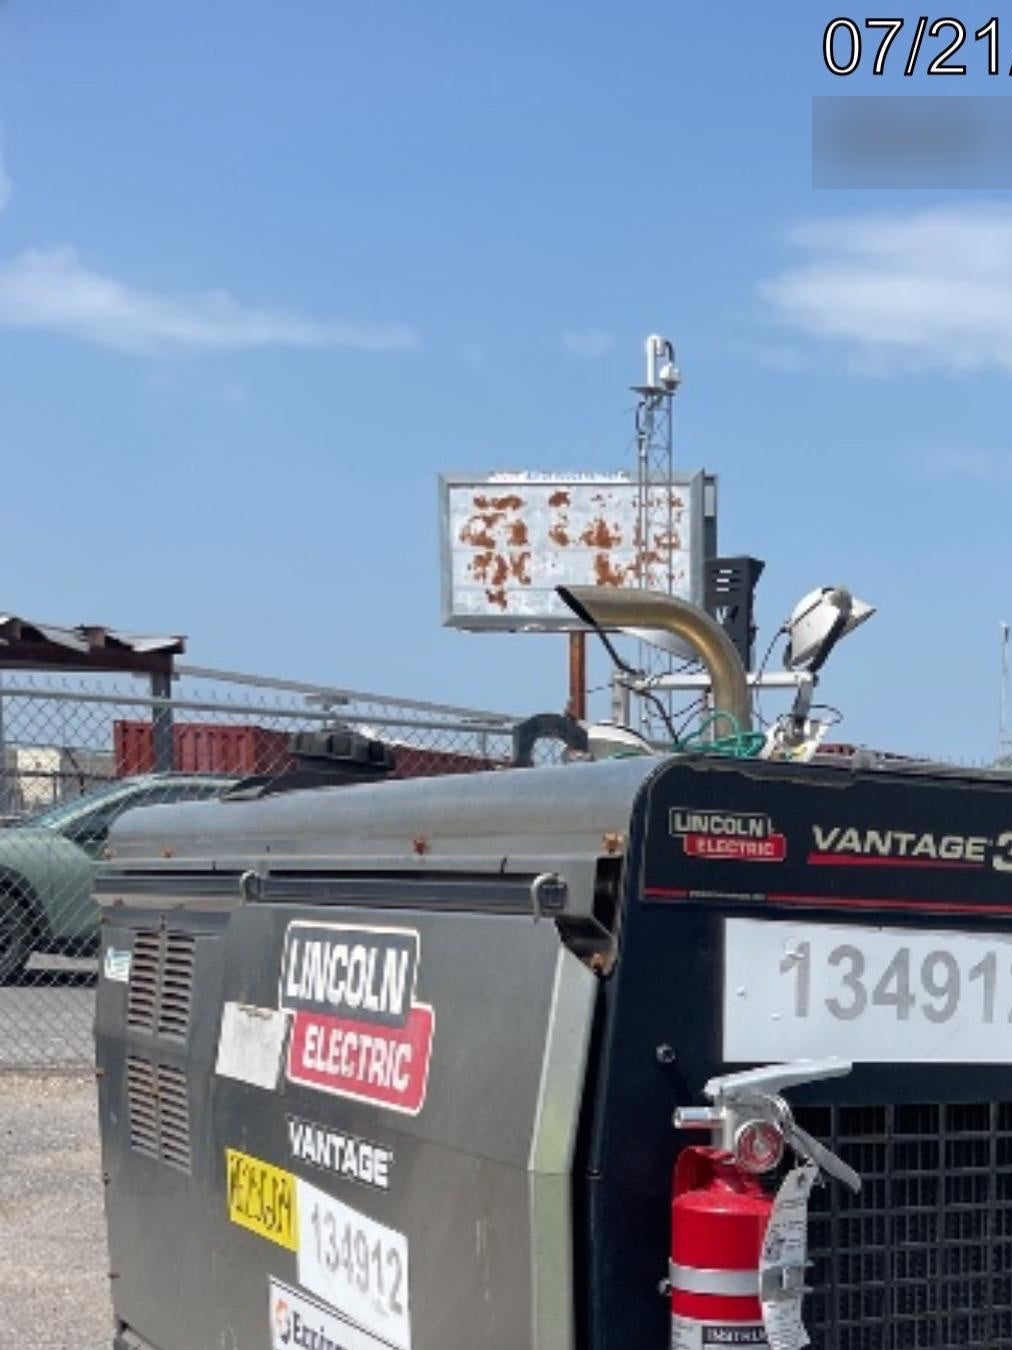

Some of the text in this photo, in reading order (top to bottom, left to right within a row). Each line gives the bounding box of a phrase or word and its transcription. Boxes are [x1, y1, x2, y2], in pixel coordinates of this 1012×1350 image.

[674, 813, 763, 838] LINCOLN
[696, 838, 775, 856] ELECTRIC
[812, 824, 988, 862] VANTAGE
[286, 937, 409, 1015] LINCOLN
[302, 1022, 413, 1093] ELECTRIC
[289, 1120, 390, 1188] VANTAGE
[311, 1202, 404, 1315] 134912
